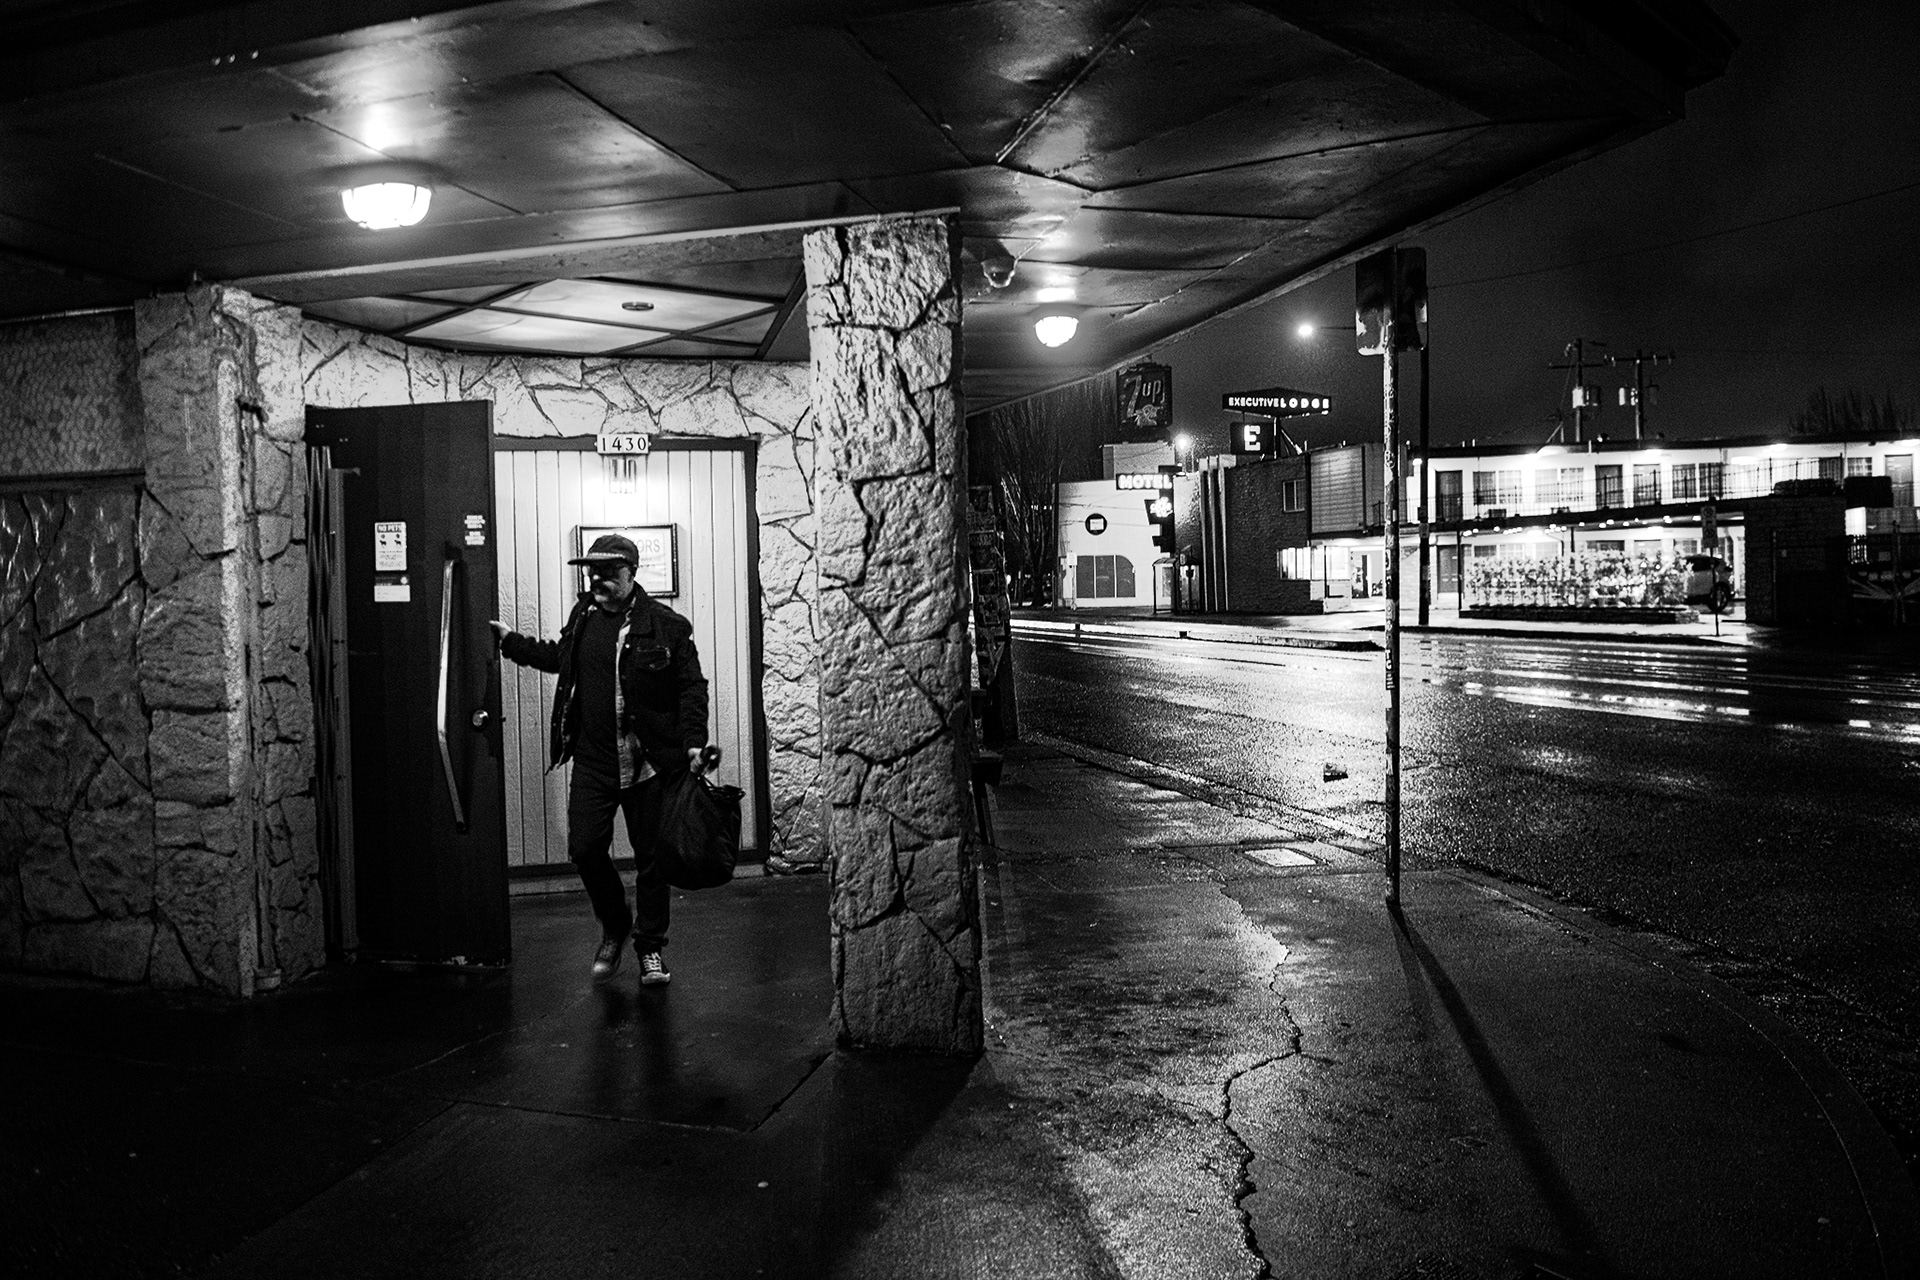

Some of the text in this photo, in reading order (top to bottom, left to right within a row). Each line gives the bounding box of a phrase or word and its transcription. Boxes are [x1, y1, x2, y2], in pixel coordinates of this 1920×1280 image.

[1228, 397, 1279, 407] EXECUTIVE
[602, 437, 646, 451] 1430
[1244, 425, 1261, 451] E
[1118, 474, 1173, 490] MOTEL
